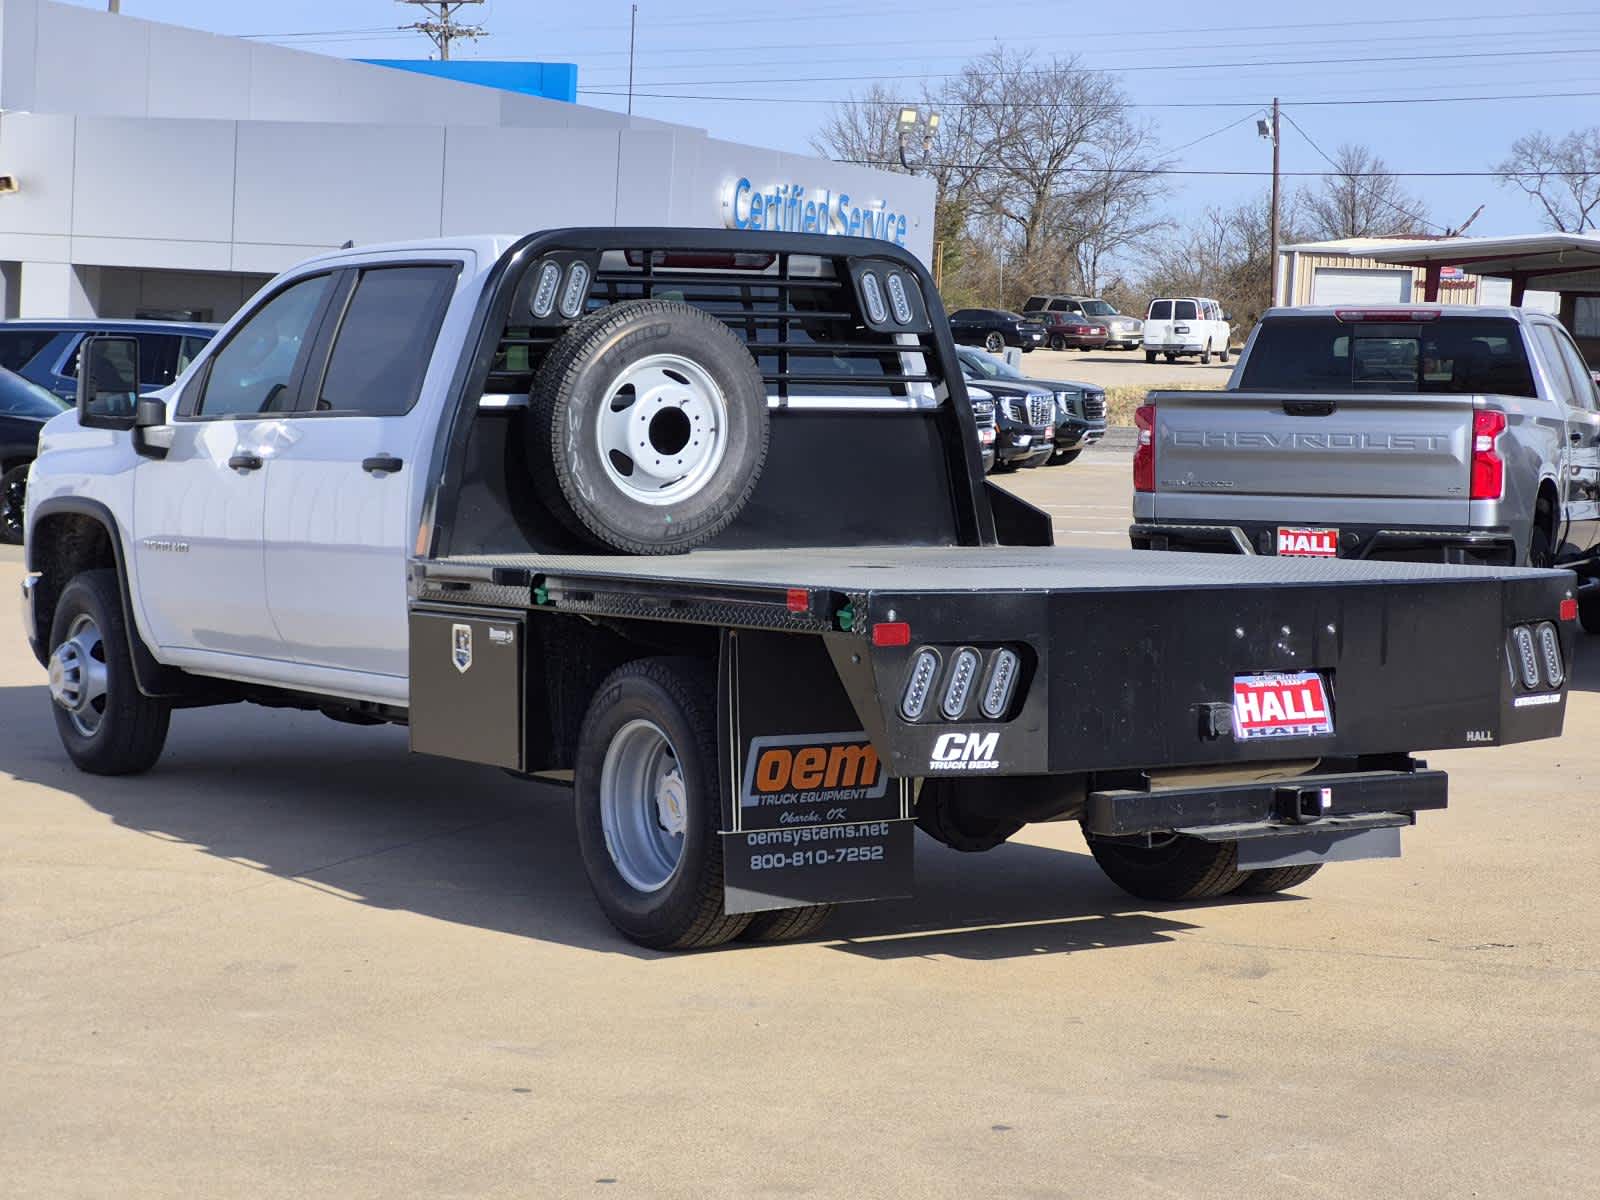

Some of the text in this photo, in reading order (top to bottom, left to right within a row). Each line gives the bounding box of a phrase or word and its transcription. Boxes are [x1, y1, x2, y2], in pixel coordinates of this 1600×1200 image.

[735, 177, 907, 246] Certified Service
[1168, 430, 1449, 450] CHEVROLET
[1279, 534, 1337, 553] HALL
[1236, 689, 1325, 722] HALL
[931, 732, 1000, 761] CM
[1466, 731, 1494, 742] HALL
[756, 744, 879, 792] oem
[929, 760, 1000, 770] TRUCK BEDS
[760, 789, 867, 806] TRUCK EQUIPMENT
[825, 807, 848, 820] OK
[747, 822, 889, 846] oemsystems.net
[750, 845, 884, 870] 800-810-7252
